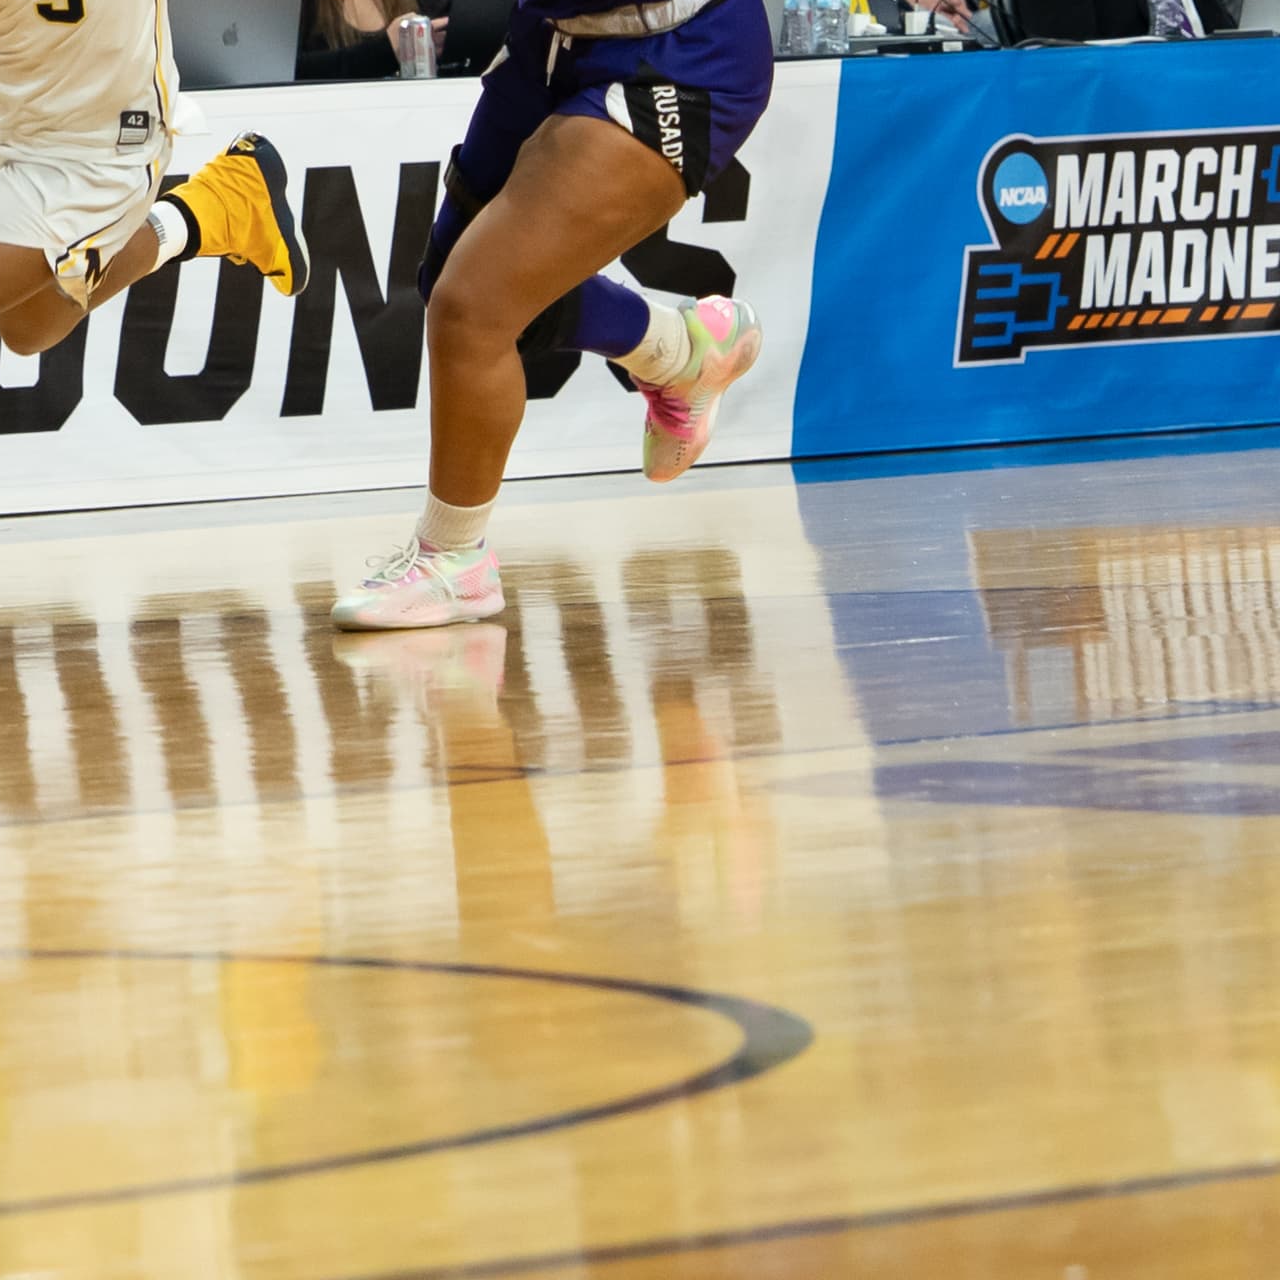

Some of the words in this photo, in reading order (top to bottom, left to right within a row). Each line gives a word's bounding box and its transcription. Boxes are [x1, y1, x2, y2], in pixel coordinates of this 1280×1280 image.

[127, 115, 144, 127] 42
[999, 185, 1047, 208] NCAA
[1053, 144, 1257, 230] MARCH
